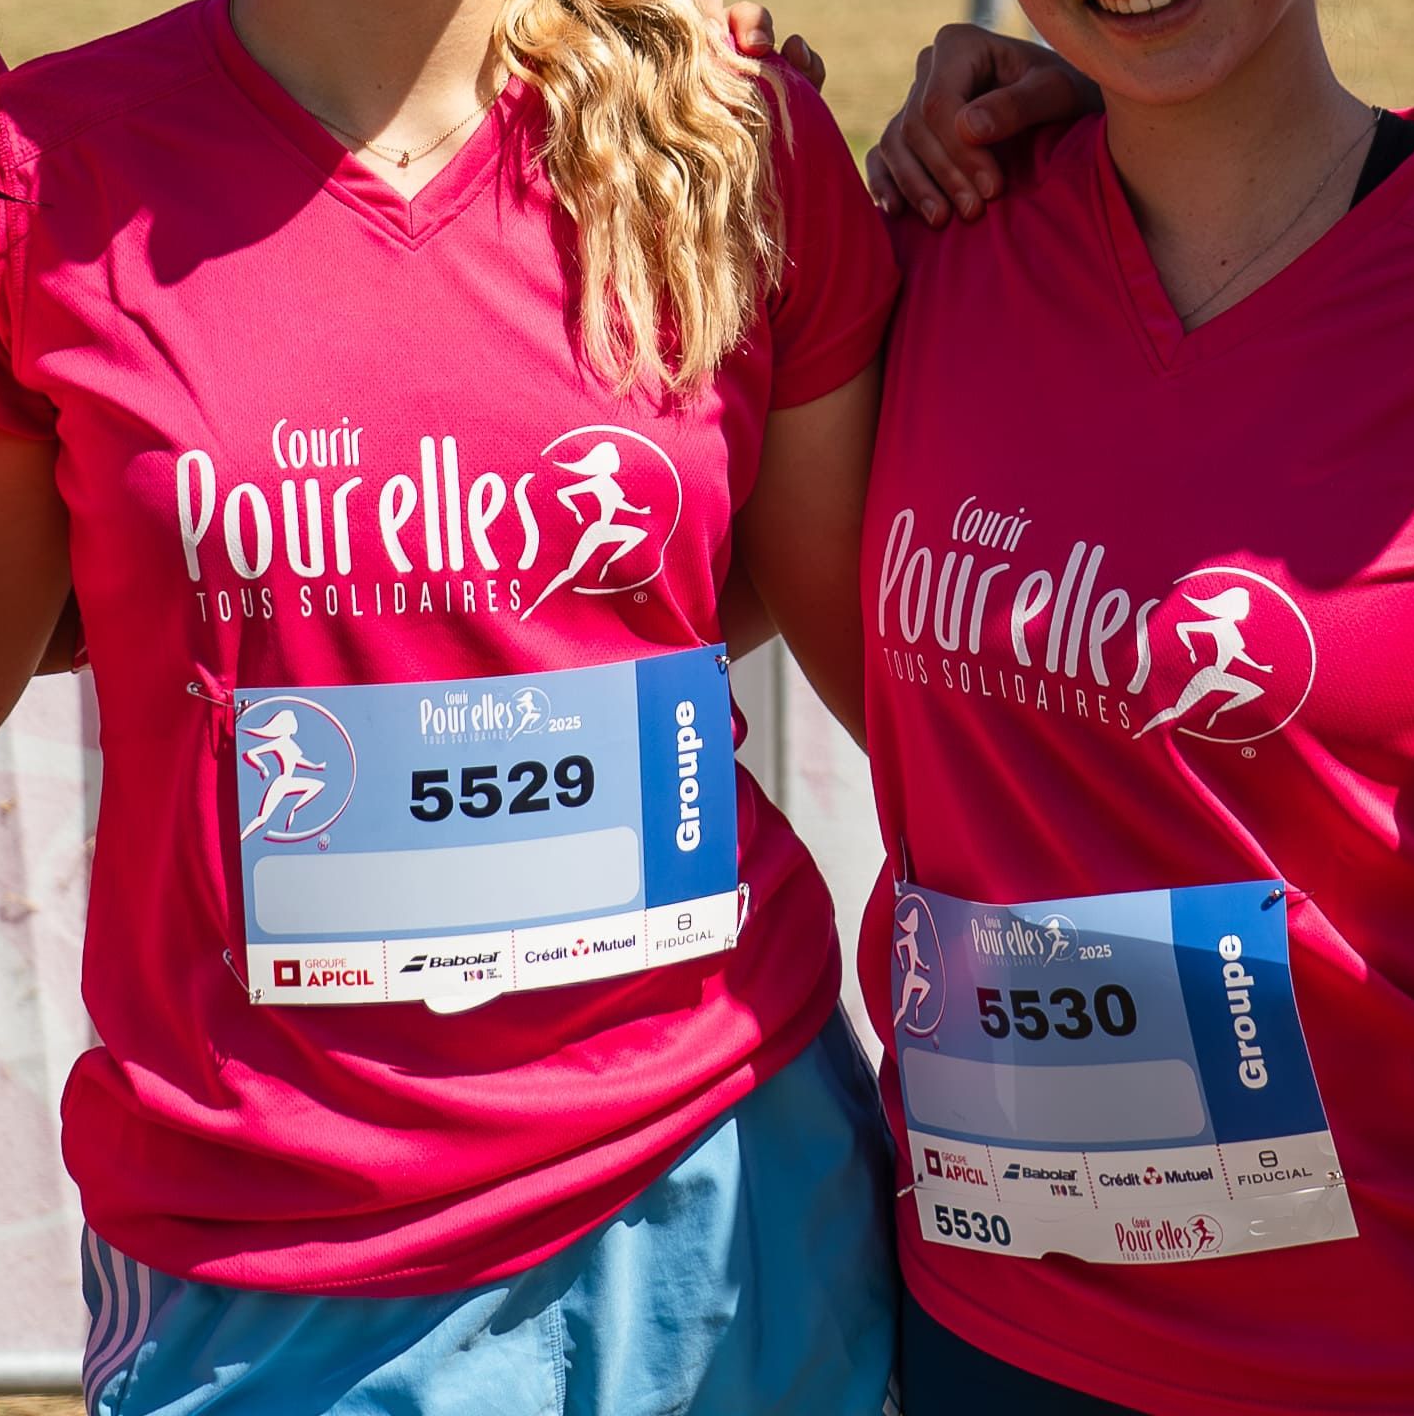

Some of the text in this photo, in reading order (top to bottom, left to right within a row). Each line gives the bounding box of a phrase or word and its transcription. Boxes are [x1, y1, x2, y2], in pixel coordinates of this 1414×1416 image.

[271, 416, 364, 470] Courir
[176, 435, 540, 583] Pour elles
[951, 496, 1033, 553] Courir
[196, 579, 523, 623] TOUS SOLIDAIRES
[877, 508, 1162, 694] Pour elles
[883, 647, 1131, 731] TOUS SOLIDAIRES
[420, 693, 514, 735] Pour elles
[548, 715, 582, 733] 2025
[409, 754, 595, 823] 5529
[675, 700, 704, 853] Groupe
[524, 934, 637, 965] Crédit Mutuel
[655, 929, 716, 951] FIDUCIAL
[970, 918, 1044, 956] Pour elles
[1078, 944, 1112, 960] 2025
[304, 958, 347, 969] GROUPE
[307, 969, 374, 987] APICIL
[976, 983, 1138, 1040] 5530
[1218, 934, 1269, 1089] Groupe
[946, 1164, 989, 1186] APICIL
[1099, 1167, 1214, 1187] Crédit Mutuel
[1237, 1167, 1313, 1186] FIDUCIAL
[934, 1203, 1012, 1247] 5530
[1115, 1219, 1192, 1252] Pour elles
